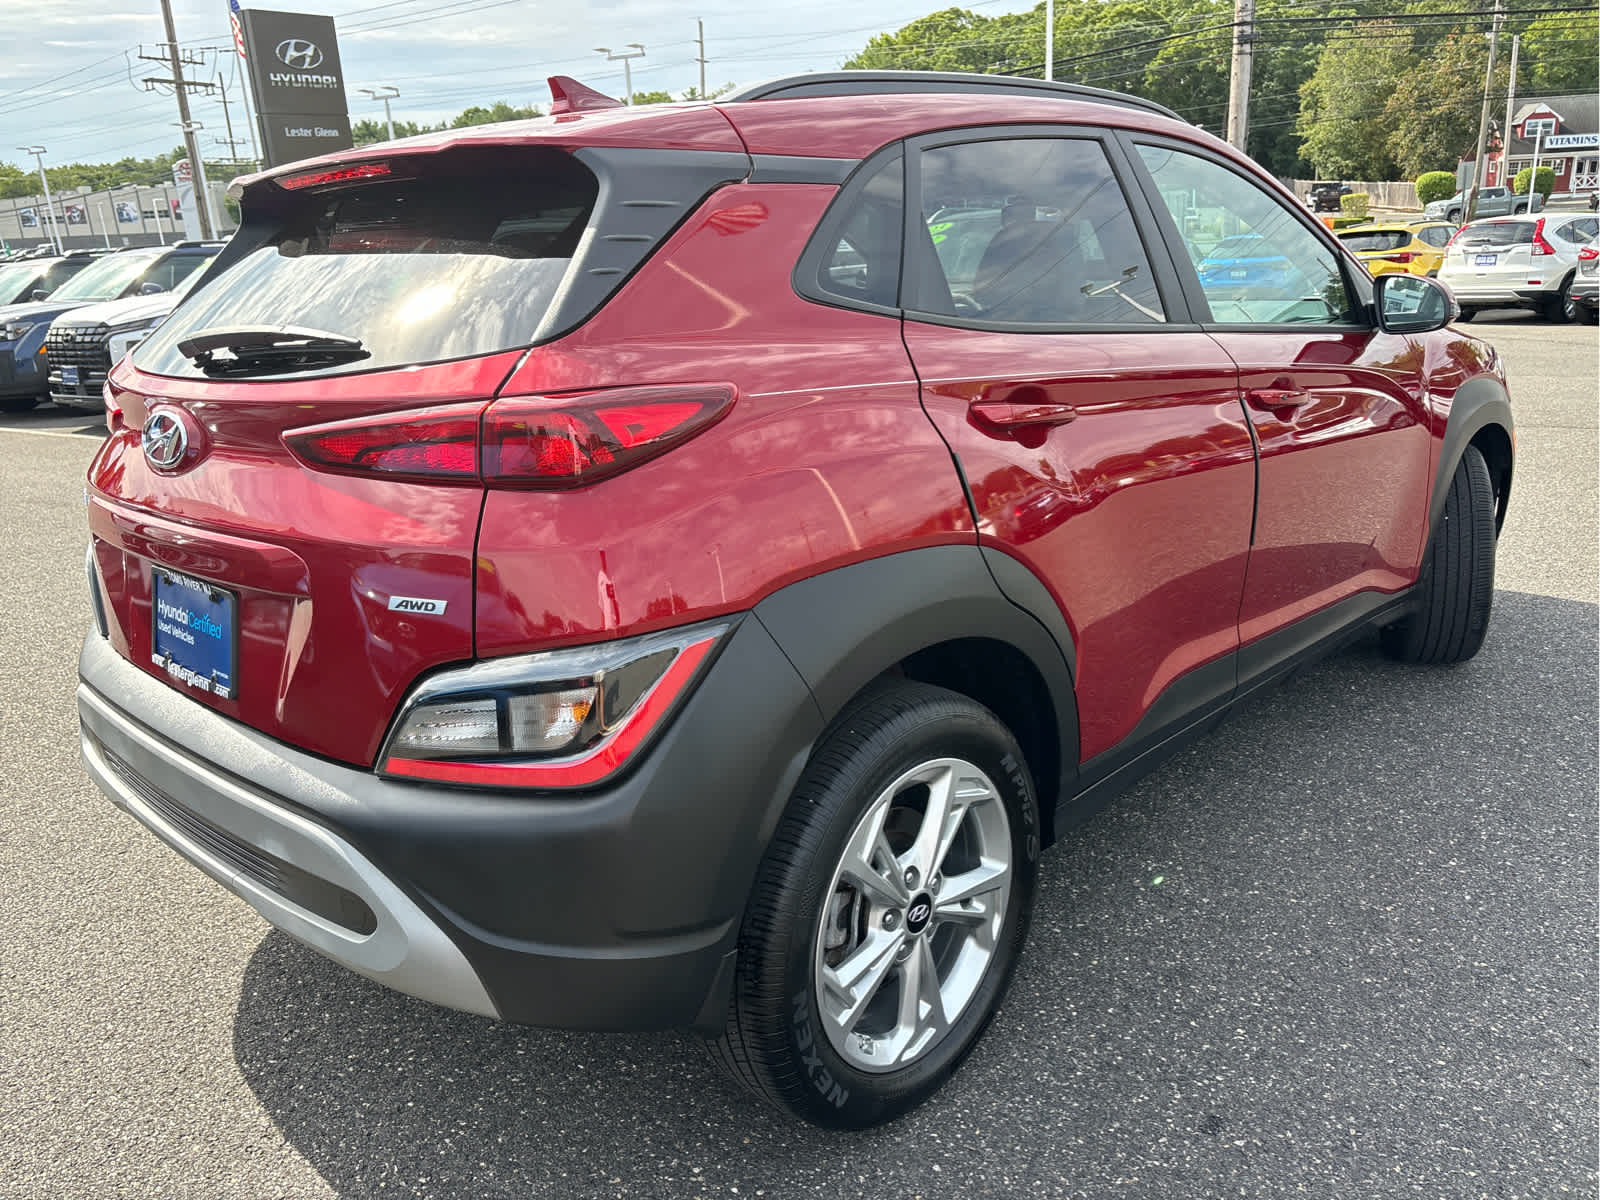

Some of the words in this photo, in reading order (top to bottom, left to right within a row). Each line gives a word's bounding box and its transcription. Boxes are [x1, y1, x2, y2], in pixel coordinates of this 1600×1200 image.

[269, 72, 338, 89] HYUNDAI
[284, 127, 312, 137] Lester
[314, 127, 340, 137] Glenn
[1549, 135, 1598, 146] VITAMINS
[394, 599, 437, 612] AWD
[157, 618, 172, 635] Used
[171, 624, 195, 645] Vehicles
[791, 987, 850, 1110] NEXEN
